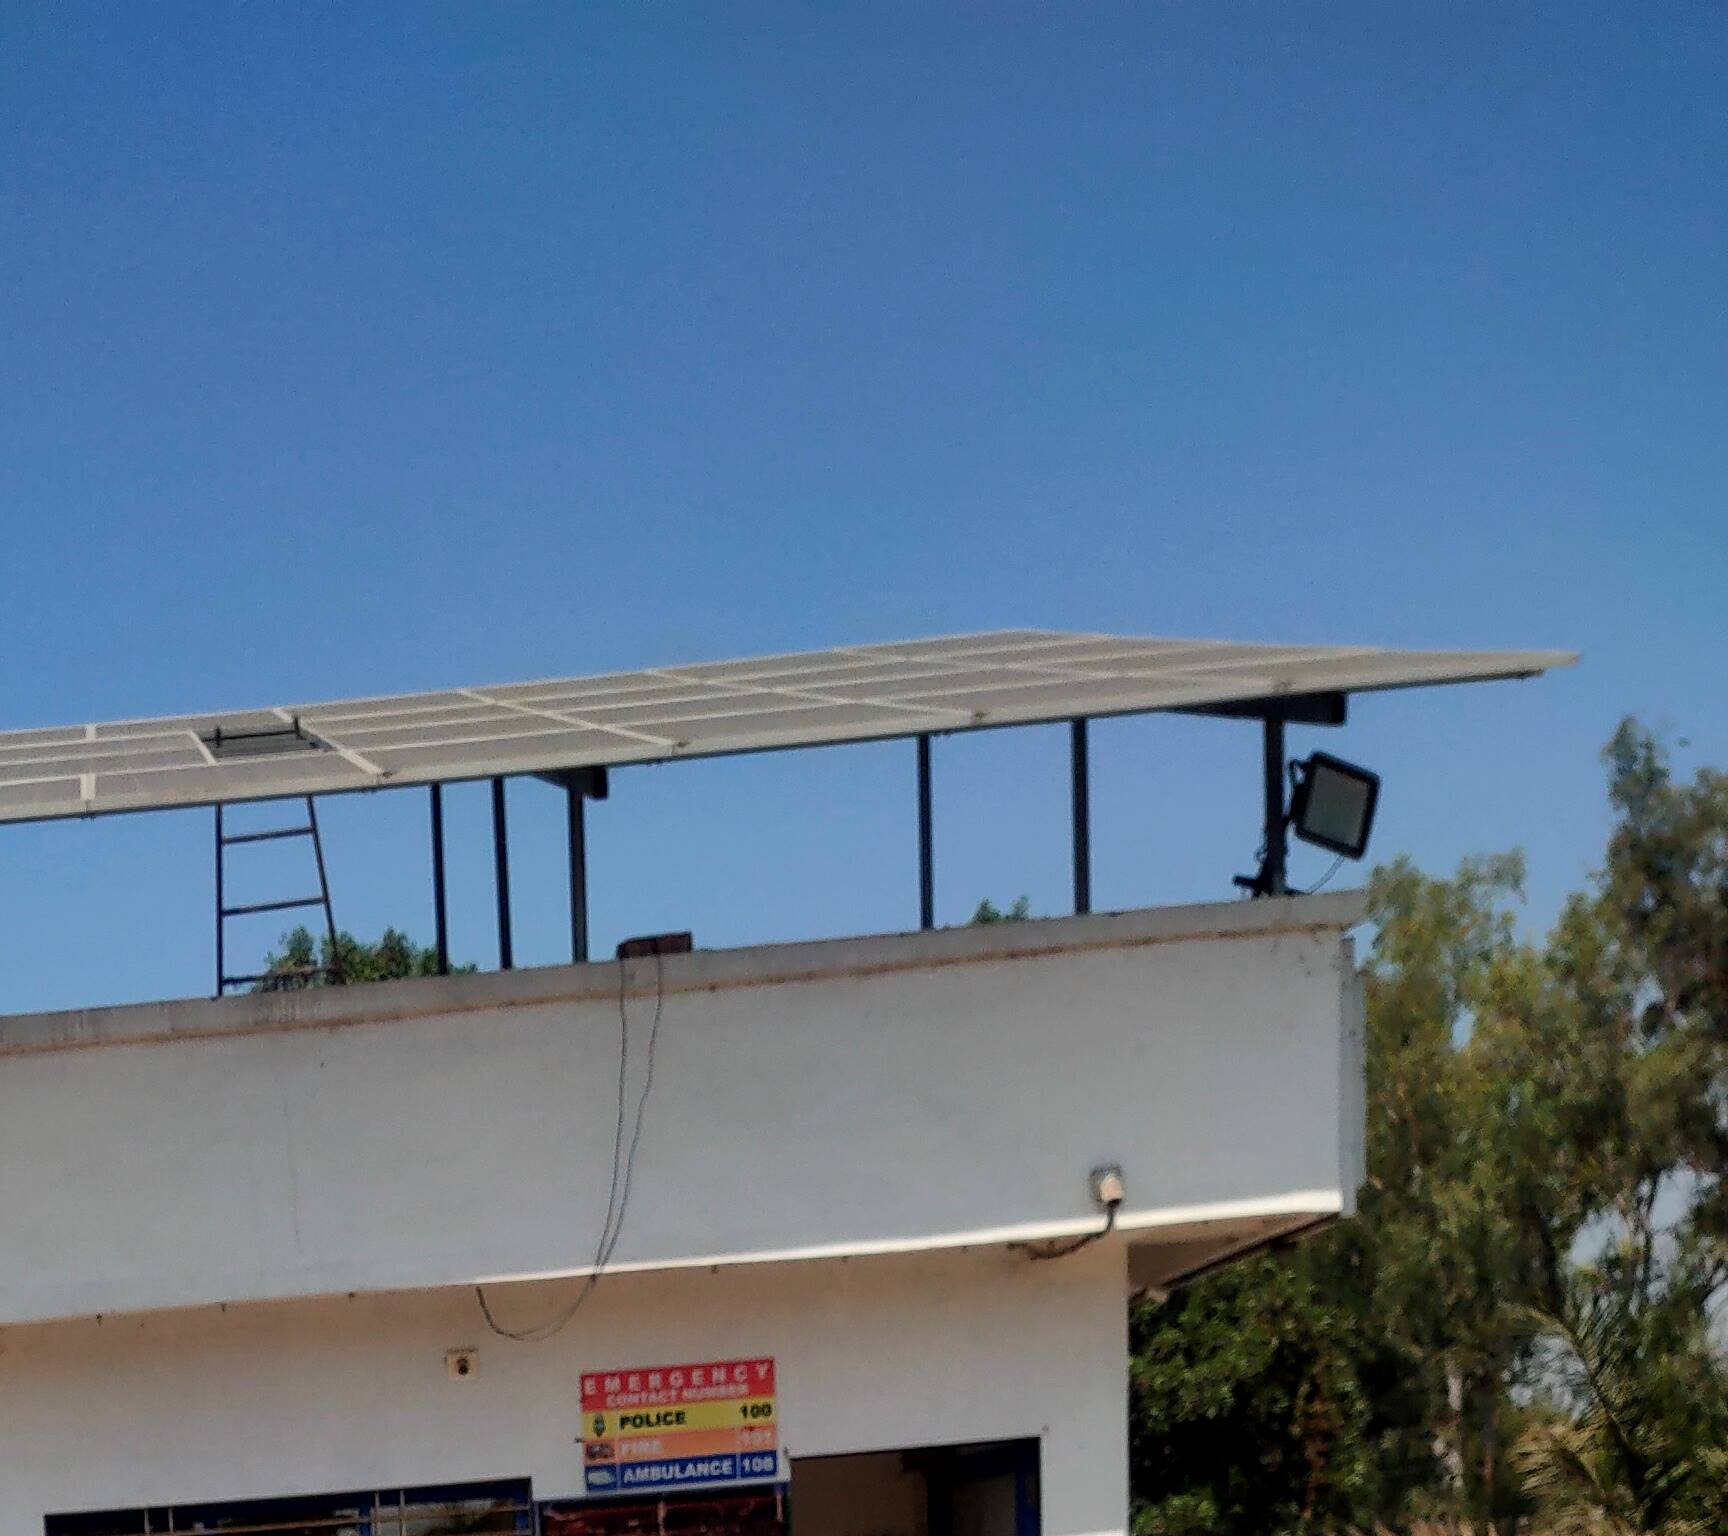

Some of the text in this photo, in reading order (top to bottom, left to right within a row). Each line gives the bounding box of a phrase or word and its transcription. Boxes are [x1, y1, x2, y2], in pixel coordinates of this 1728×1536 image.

[583, 1363, 770, 1395] EMERGENCY
[619, 1403, 772, 1430] POLICE 100
[623, 1456, 734, 1484] AMBULANCE
